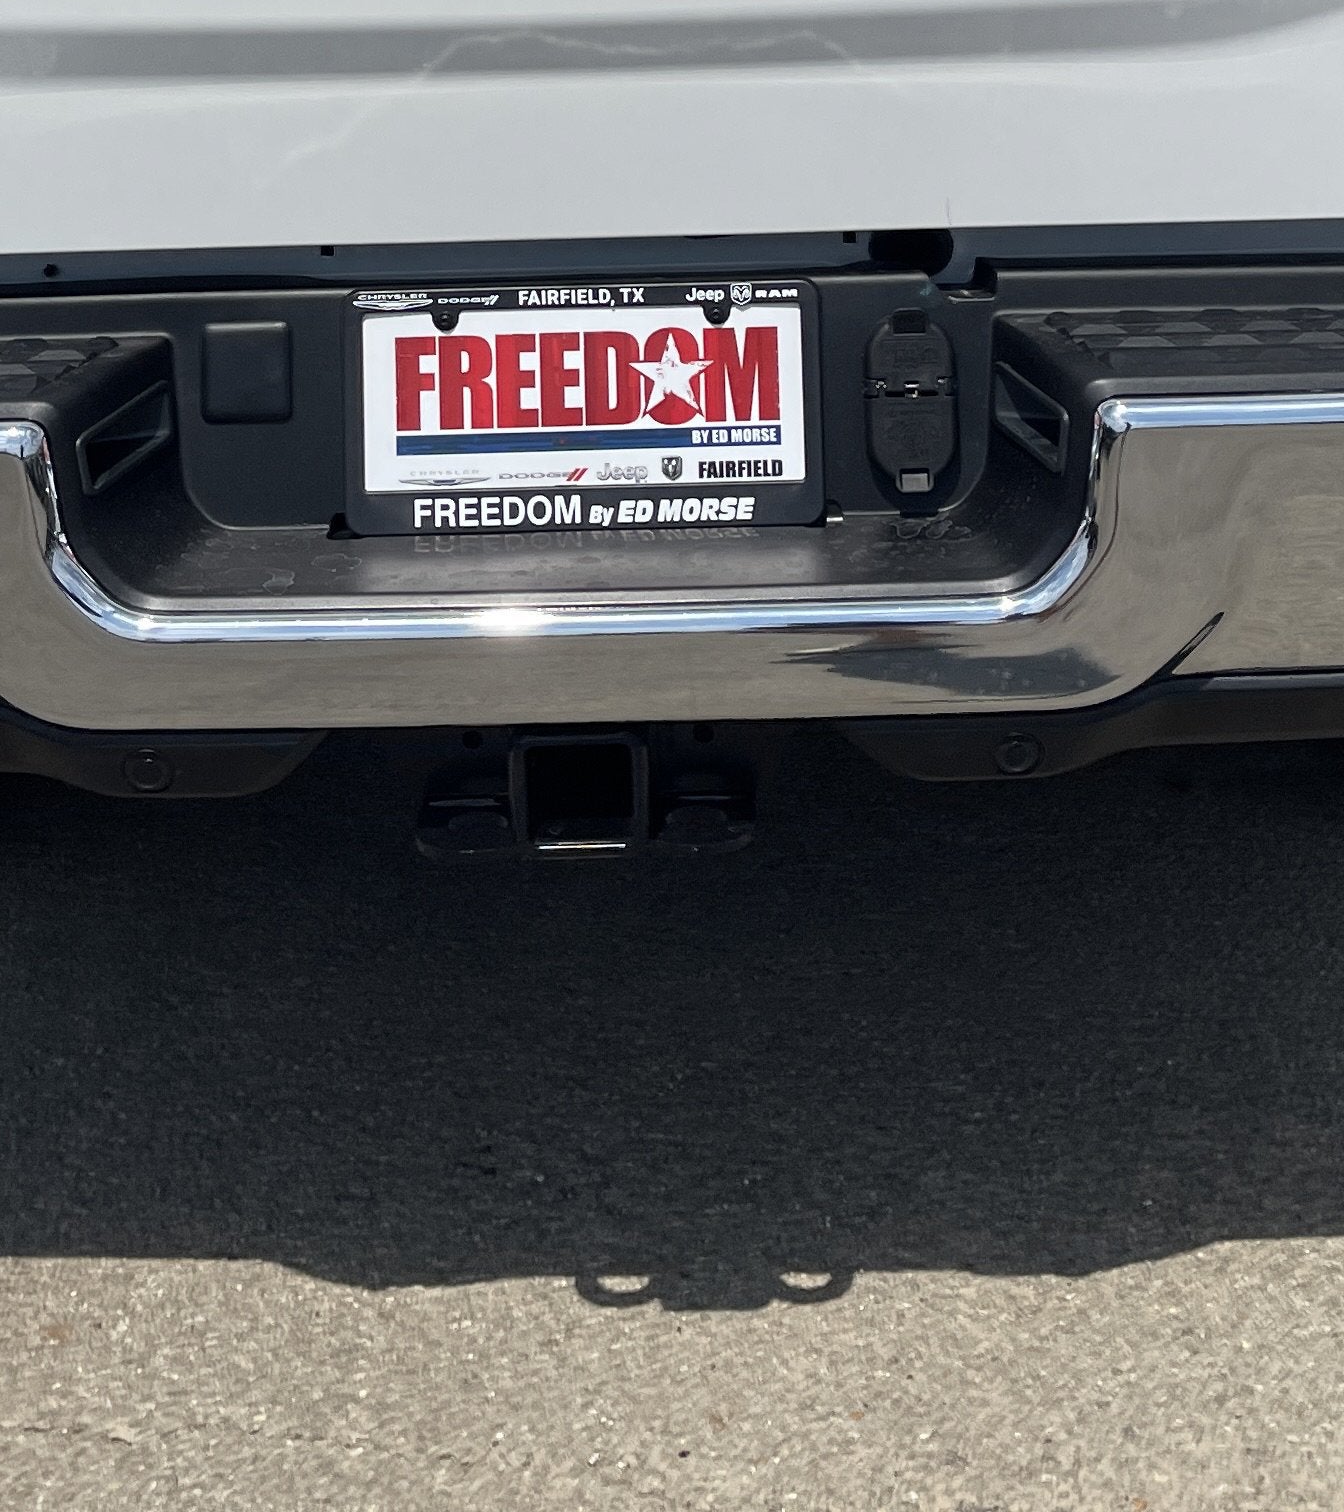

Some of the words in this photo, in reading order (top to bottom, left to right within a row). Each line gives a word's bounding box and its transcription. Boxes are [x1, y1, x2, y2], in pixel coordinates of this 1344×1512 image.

[357, 293, 428, 301] CHRYSLER
[518, 288, 616, 307] FAIRFIELD,
[619, 287, 645, 303] TX
[685, 288, 725, 303] Jeep
[755, 288, 798, 298] RAM
[395, 326, 780, 431] FREEDOM
[691, 429, 709, 444] BY
[711, 429, 728, 443] ED
[730, 427, 777, 442] MORSE
[410, 469, 480, 477] CHRYSLER
[498, 471, 571, 480] DODGE
[596, 463, 648, 482] Jeep
[698, 459, 783, 479] FAIRFIELD
[413, 494, 581, 529] FREEDOM
[588, 504, 613, 527] By
[617, 500, 654, 524] ED
[657, 496, 756, 522] MORSE
